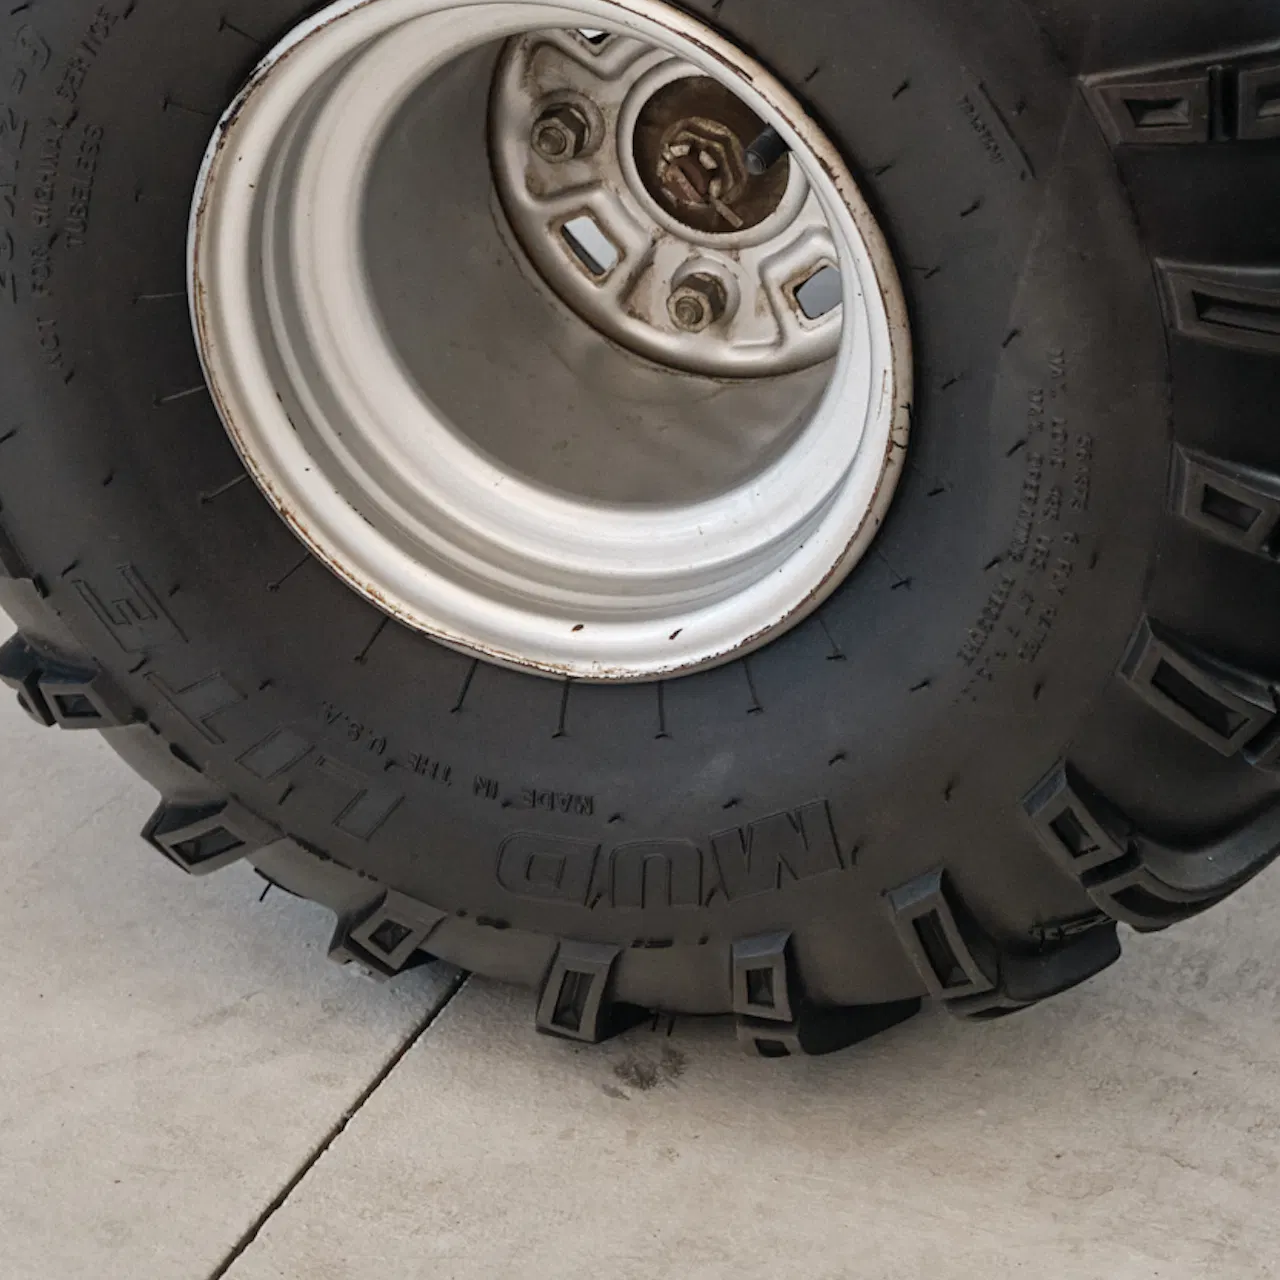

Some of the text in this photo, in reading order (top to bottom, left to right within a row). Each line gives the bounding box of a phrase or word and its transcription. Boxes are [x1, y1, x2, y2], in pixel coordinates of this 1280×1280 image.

[72, 564, 845, 910] MUD LITE
[473, 774, 500, 800] IN
[522, 788, 594, 817] MADE
